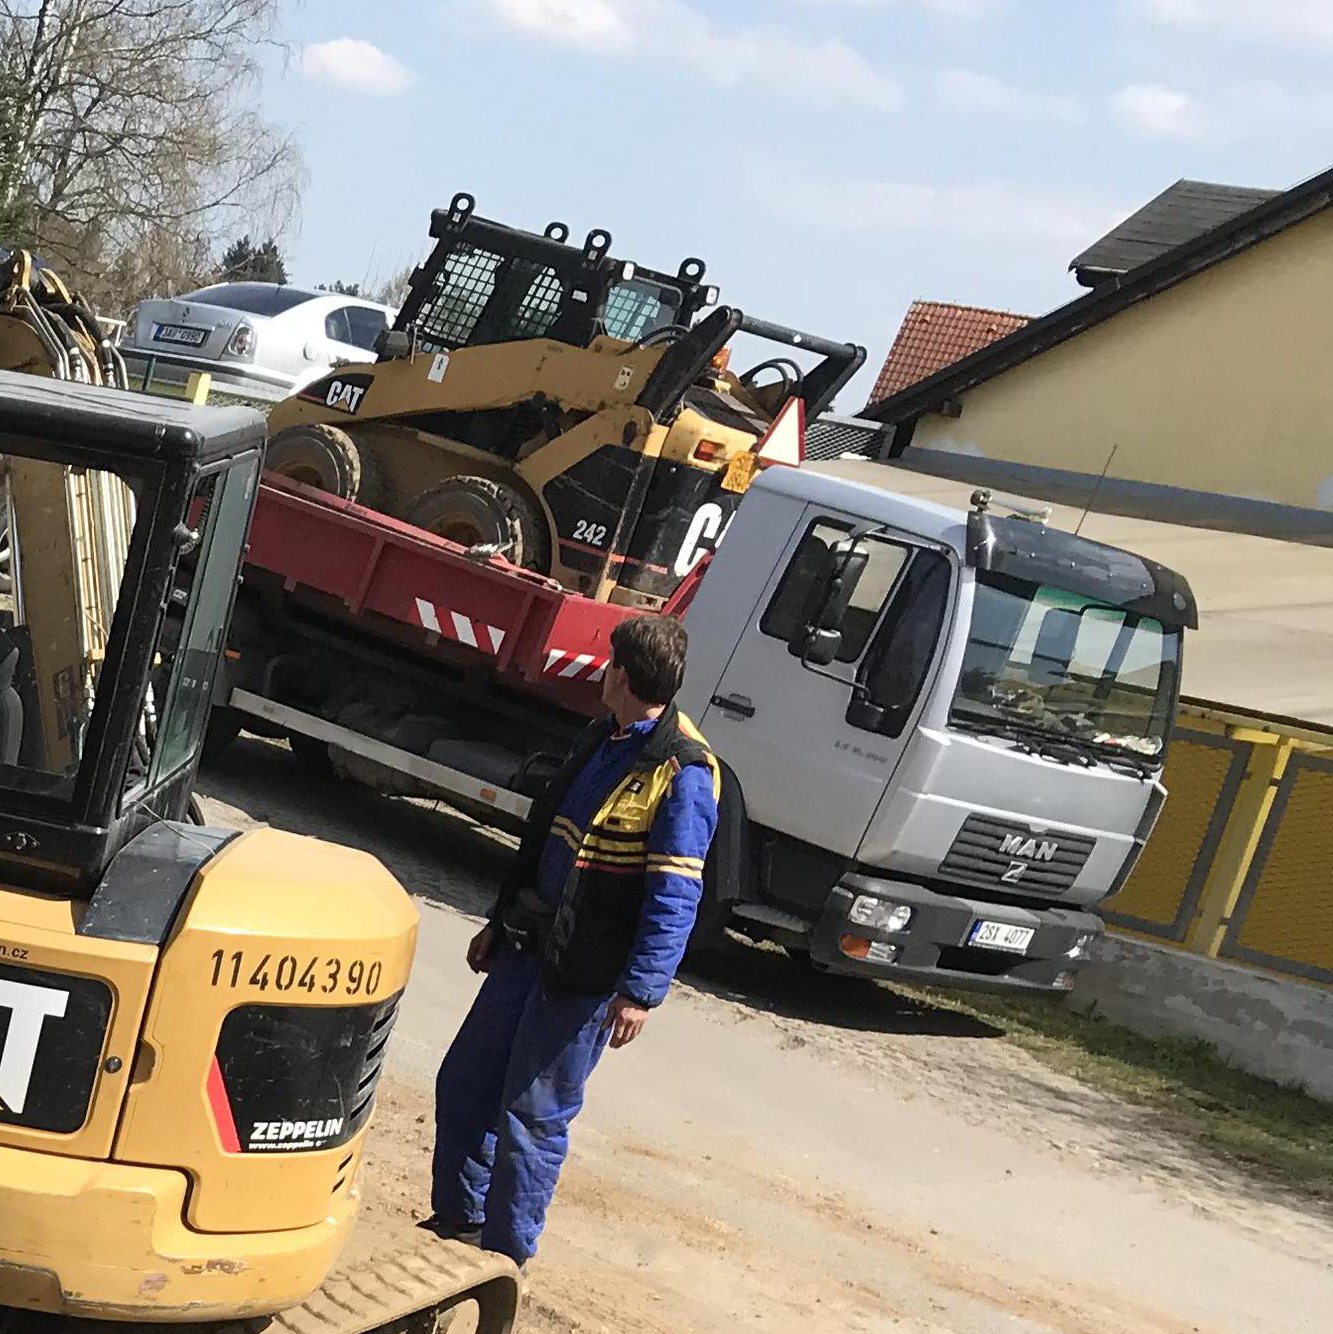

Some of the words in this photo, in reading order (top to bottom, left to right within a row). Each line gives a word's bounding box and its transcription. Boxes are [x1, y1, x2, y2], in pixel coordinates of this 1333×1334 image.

[326, 381, 364, 412] CAT
[573, 520, 607, 546] 242
[999, 834, 1058, 861] MAN
[1004, 928, 1030, 945] 4077
[211, 949, 382, 996] 11404390
[250, 1118, 344, 1140] ZEPPELIN
